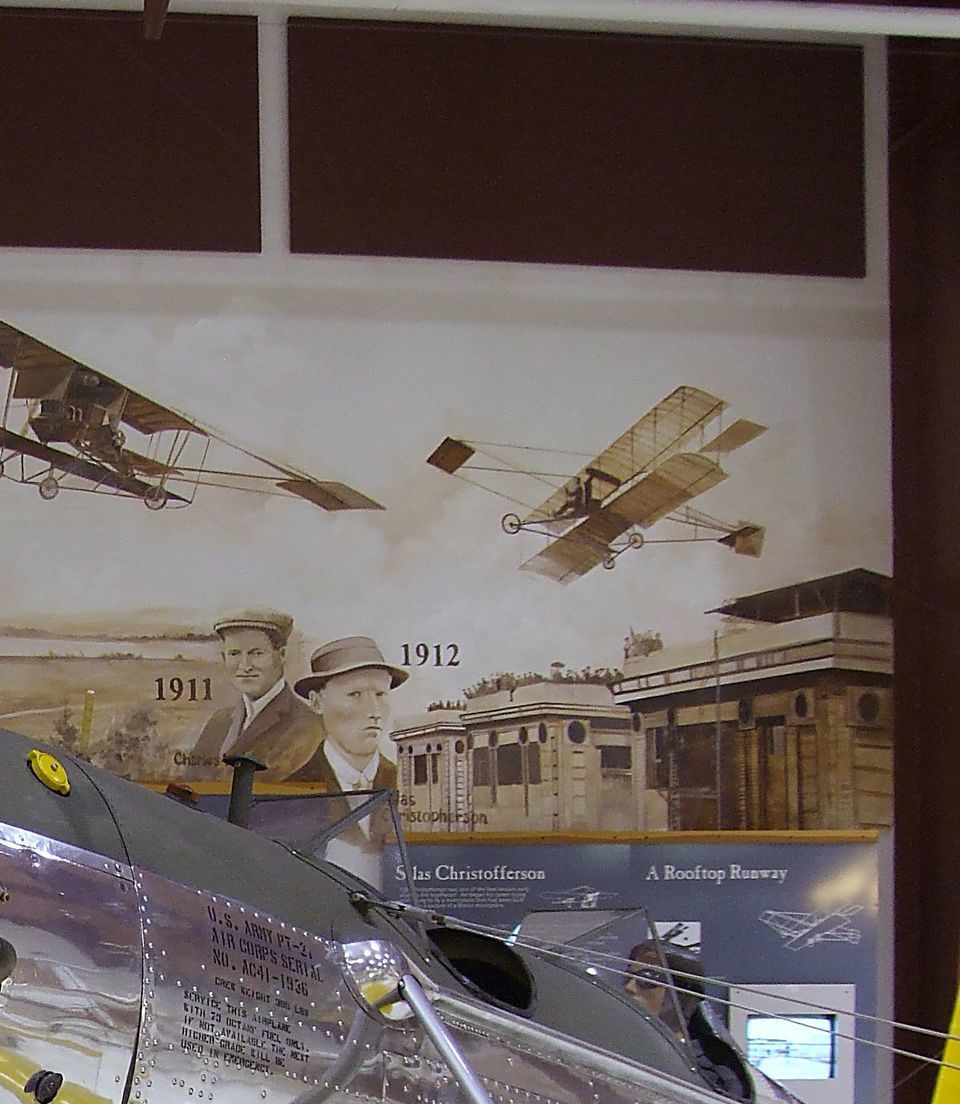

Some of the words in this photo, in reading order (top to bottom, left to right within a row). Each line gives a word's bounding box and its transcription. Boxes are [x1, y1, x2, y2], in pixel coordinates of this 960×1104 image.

[400, 643, 460, 667] 1912
[154, 677, 214, 702] 1911
[395, 864, 431, 880] Slas
[435, 864, 546, 880] Christofferson
[646, 866, 659, 880] A
[664, 865, 726, 884] Rooftop
[730, 864, 788, 884] Runway
[207, 905, 239, 931] U.S.
[245, 920, 273, 944] ARMY
[212, 927, 236, 950] AIR
[240, 938, 278, 964] CORPS
[280, 953, 323, 983] SERIAL
[213, 948, 236, 971] NO.
[242, 959, 309, 997] AC41-1936
[183, 990, 221, 1011] SERVICE
[226, 1004, 247, 1018] THIS
[184, 1015, 194, 1024] IF
[199, 1020, 216, 1033] NOT
[271, 1043, 286, 1056] THE
[219, 1039, 246, 1055] GRADE
[261, 1030, 281, 1043] FUEL
[180, 1039, 203, 1055] USED
[209, 1048, 219, 1059] IN
